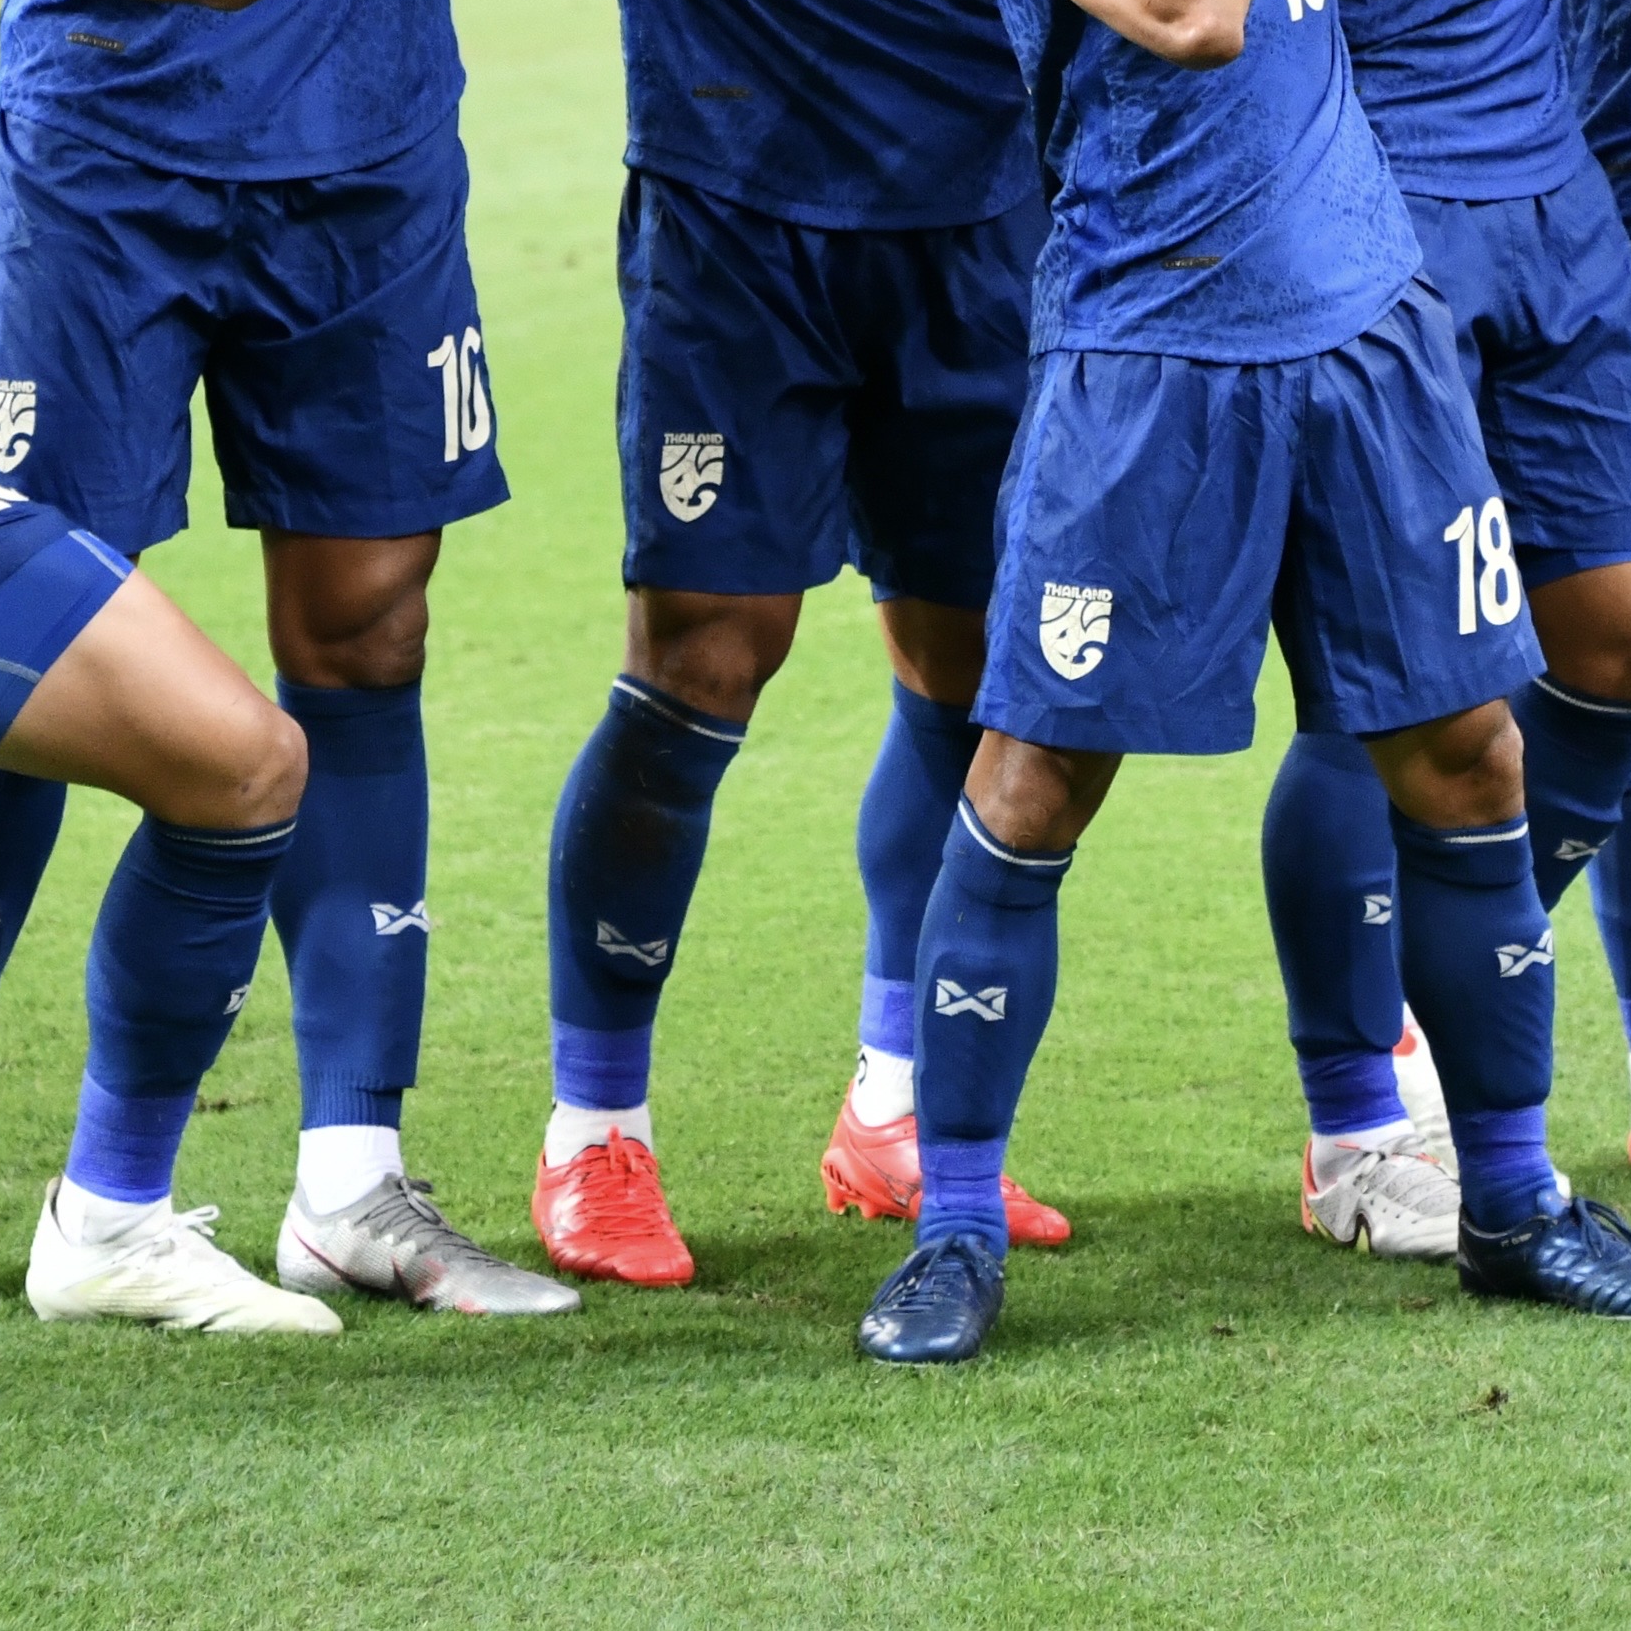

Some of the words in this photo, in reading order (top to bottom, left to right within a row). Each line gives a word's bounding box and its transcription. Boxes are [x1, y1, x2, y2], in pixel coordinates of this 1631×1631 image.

[427, 325, 491, 463] 10
[662, 431, 724, 447] THAILAND
[1043, 581, 1113, 602] THAILAND
[1444, 496, 1522, 636] 18
